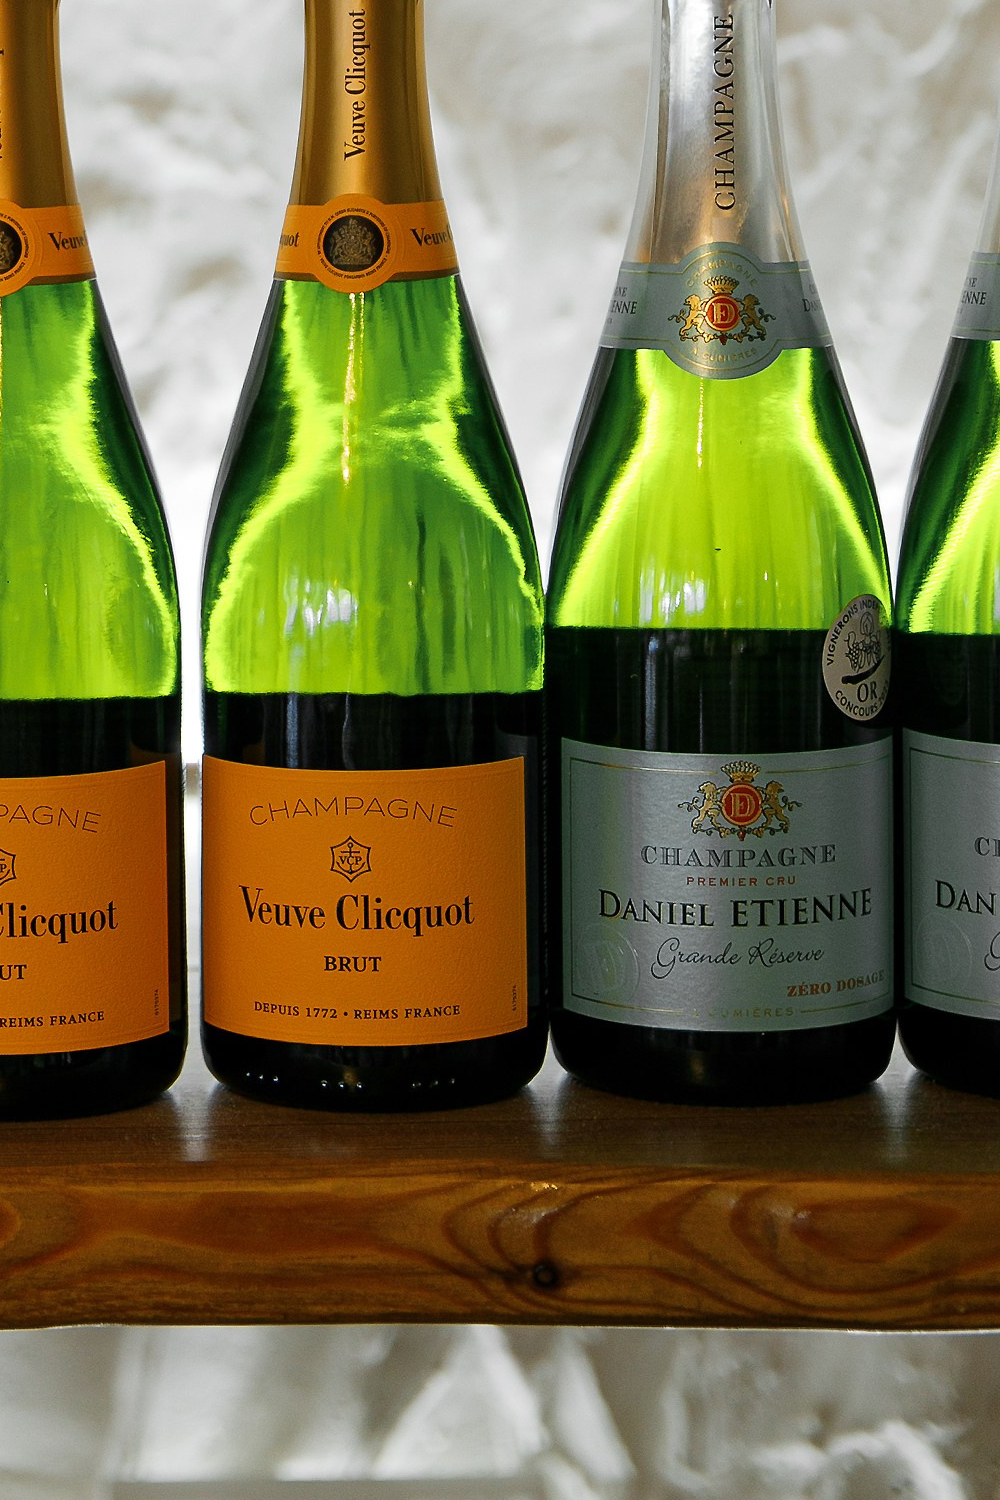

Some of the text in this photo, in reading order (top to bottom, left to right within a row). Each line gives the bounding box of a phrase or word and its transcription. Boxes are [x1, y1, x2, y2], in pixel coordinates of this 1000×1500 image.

[344, 8, 370, 161] Veuve Clicquot
[713, 14, 736, 210] CHAMPAGNE
[826, 603, 859, 667] VIGNERONS
[835, 690, 878, 718] CONCOURS
[857, 680, 878, 703] OR
[250, 796, 458, 828] CHAMPAGNE
[640, 844, 837, 869] CHAMPAGNE
[686, 875, 796, 887] PREMIER CRU
[238, 885, 475, 937] Veuve Clicquot
[599, 887, 872, 928] DANIEL ETIENNE
[323, 956, 382, 973] BRUT
[650, 937, 825, 980] Grande Réserve
[786, 969, 886, 998] ZÉRO DOSAGE
[49, 1011, 105, 1026] FRANCE
[254, 1001, 461, 1020] DEPUIS 1772 REIMS FRANCE
